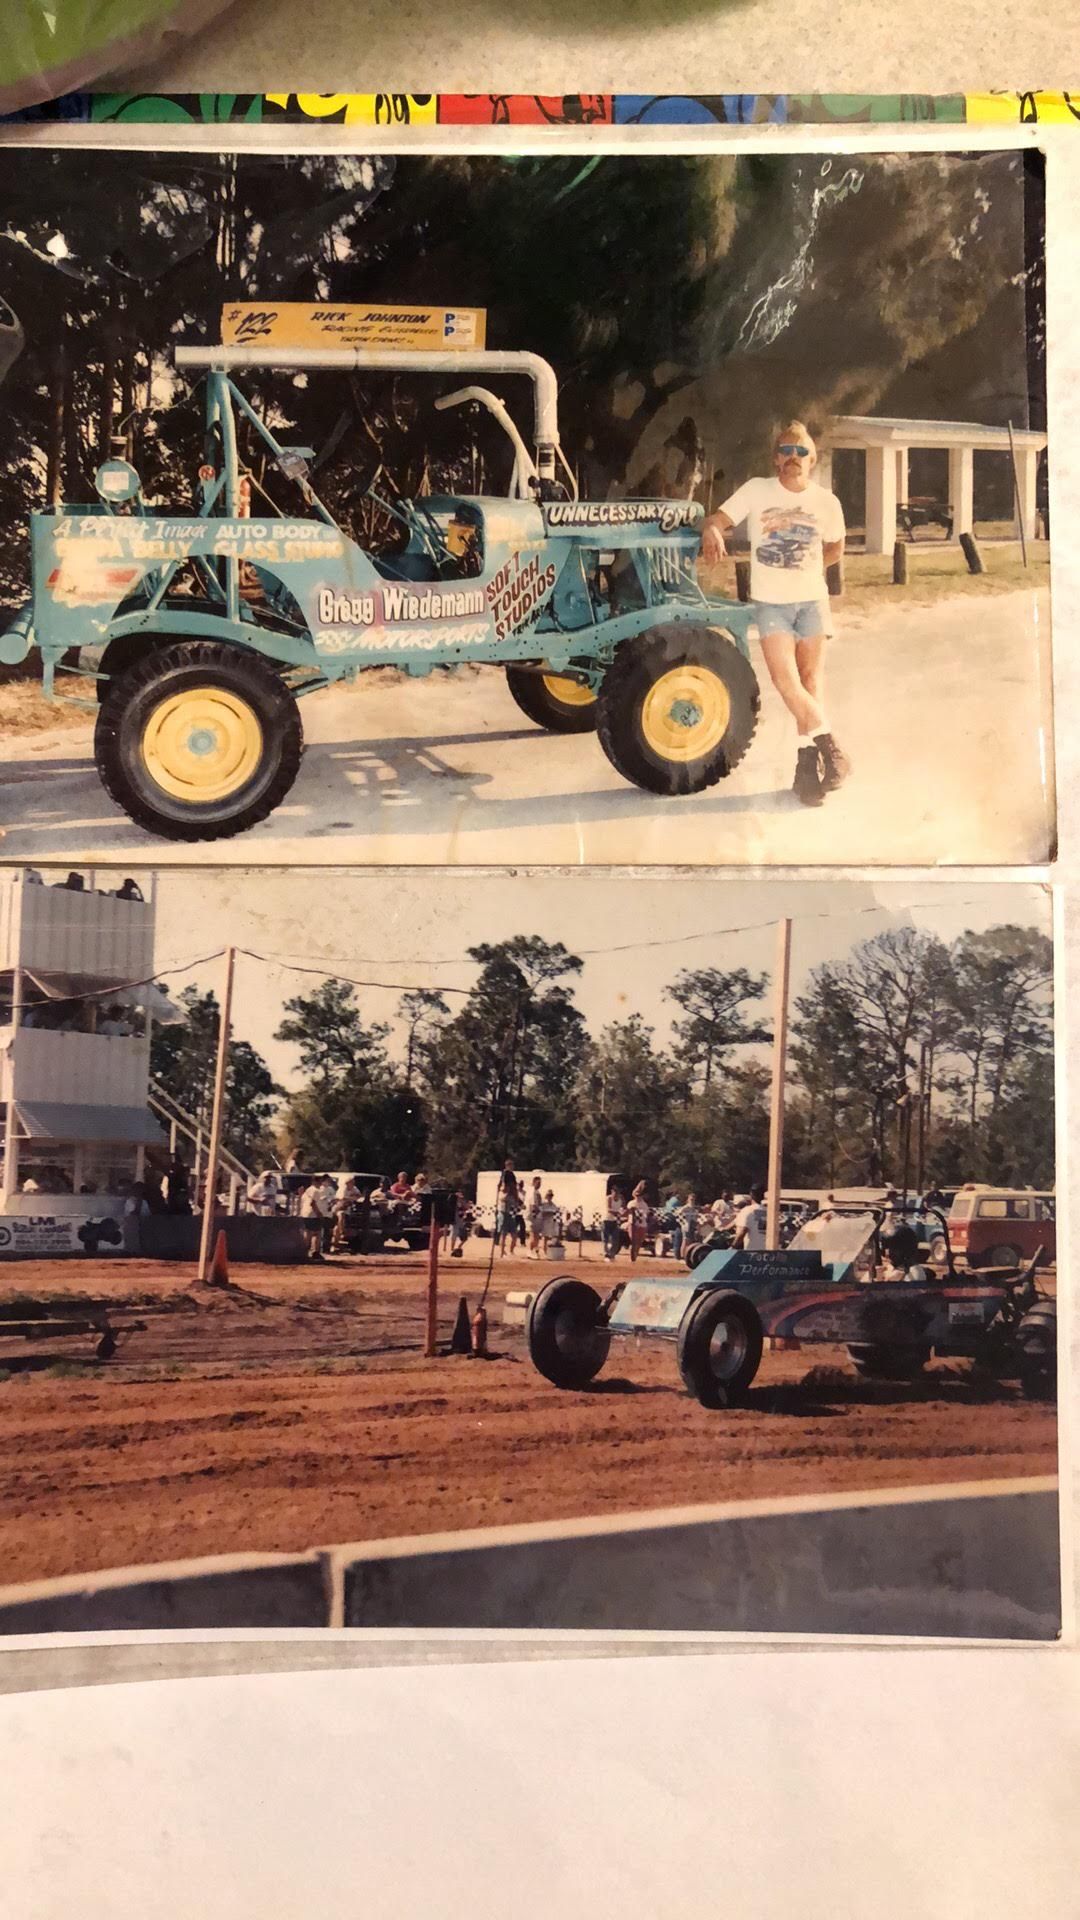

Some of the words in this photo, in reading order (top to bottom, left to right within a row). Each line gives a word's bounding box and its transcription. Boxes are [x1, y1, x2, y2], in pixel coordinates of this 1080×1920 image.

[310, 311, 352, 321] RICK
[52, 518, 73, 537] A
[215, 524, 267, 540] AUTO
[272, 524, 322, 540] BODY
[549, 503, 666, 525] UNNECESSARY
[486, 550, 520, 602] SOFT
[491, 554, 540, 622] TOUCH
[319, 588, 375, 625] Gregg
[382, 587, 485, 621] Wiedemann
[495, 562, 556, 642] STUDIOS
